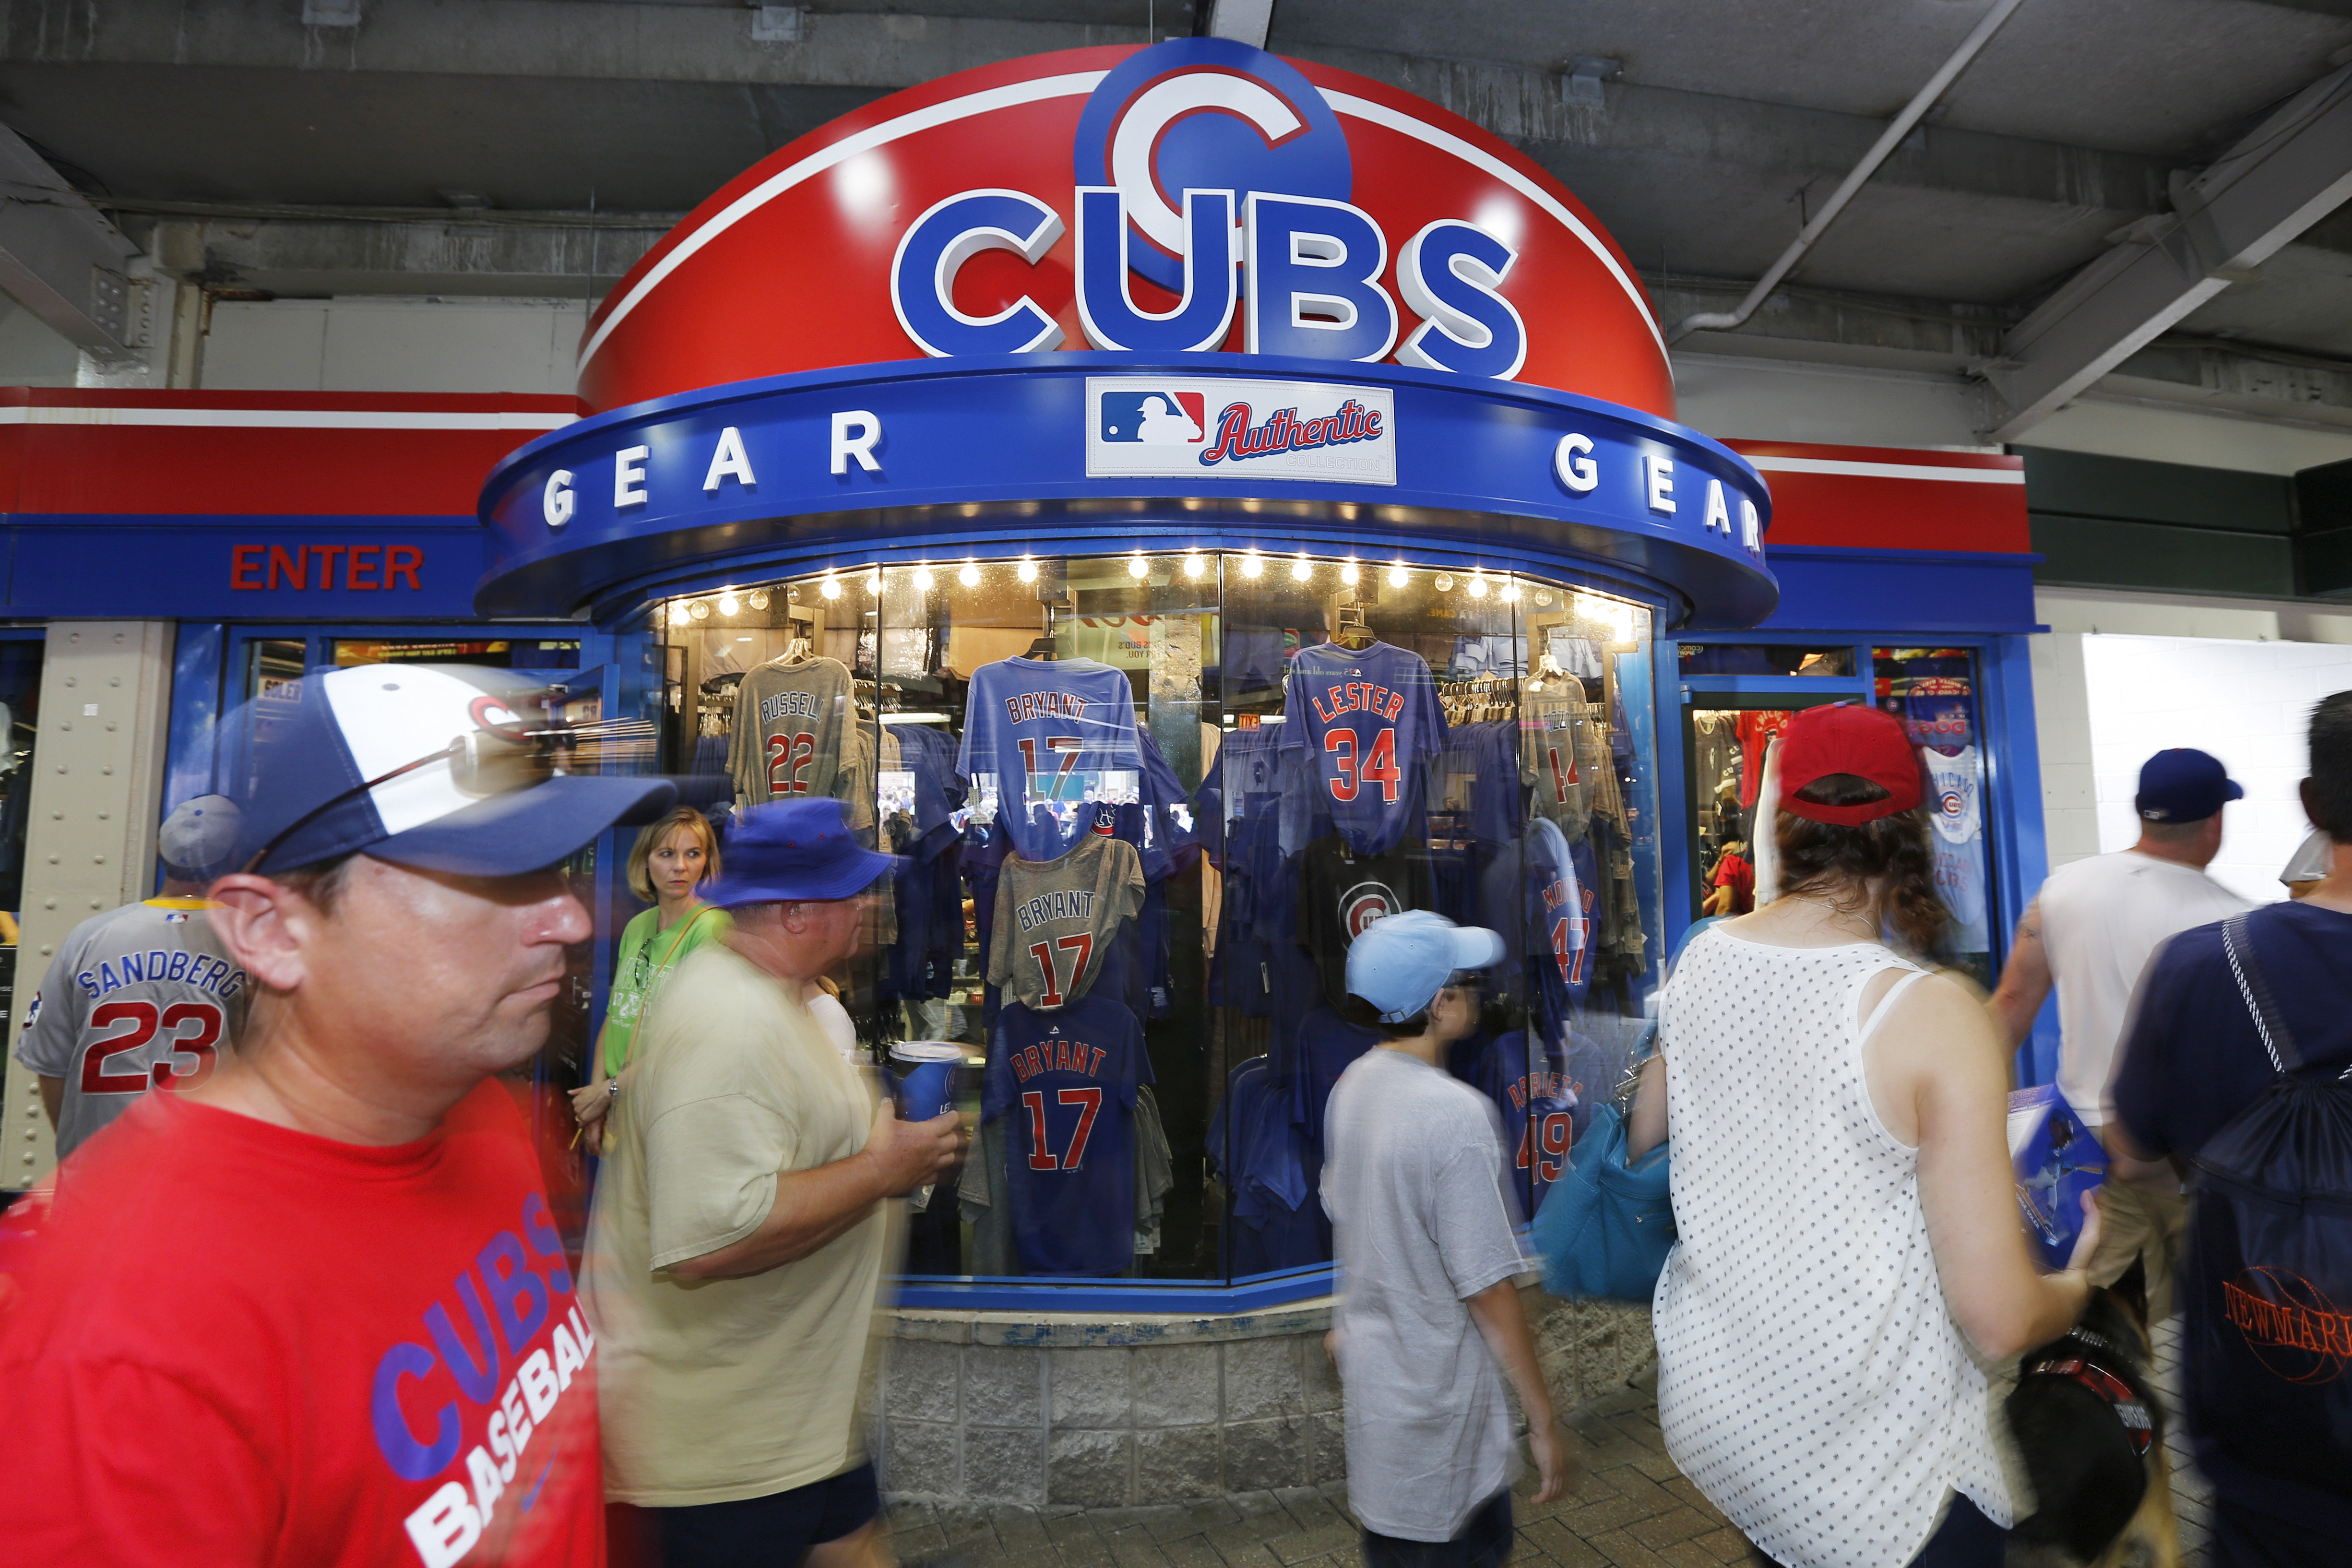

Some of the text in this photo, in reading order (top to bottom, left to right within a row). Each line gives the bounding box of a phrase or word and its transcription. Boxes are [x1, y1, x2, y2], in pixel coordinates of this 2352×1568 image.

[891, 185, 1528, 380] CUBS
[1199, 399, 1384, 466] Authentic
[1286, 454, 1380, 472] COLLECTION
[543, 410, 882, 526] GEAR
[1555, 432, 1761, 553] GEAR
[230, 545, 425, 591] ENTER
[761, 690, 824, 725] RUSSELL
[1005, 691, 1089, 725] BRYANT
[1312, 682, 1405, 724] LESTER
[767, 732, 815, 795] 22
[1017, 736, 1084, 807] 17
[1324, 727, 1401, 802] 34
[1017, 890, 1095, 933] BRYANT
[77, 950, 249, 1001] SANDBERG
[1028, 931, 1093, 1008] 17
[1552, 917, 1590, 984] 47
[80, 1000, 224, 1095] 23
[1010, 1040, 1106, 1083] BRYANT
[1508, 1072, 1584, 1112] ARRIETA
[2007, 1097, 2035, 1108] LER
[1022, 1087, 1102, 1170] 17
[1517, 1112, 1573, 1185] 49
[2016, 1192, 2040, 1230] ORGE SOLER
[371, 1191, 572, 1482] CUBS
[404, 1295, 596, 1568] BASEBAL
